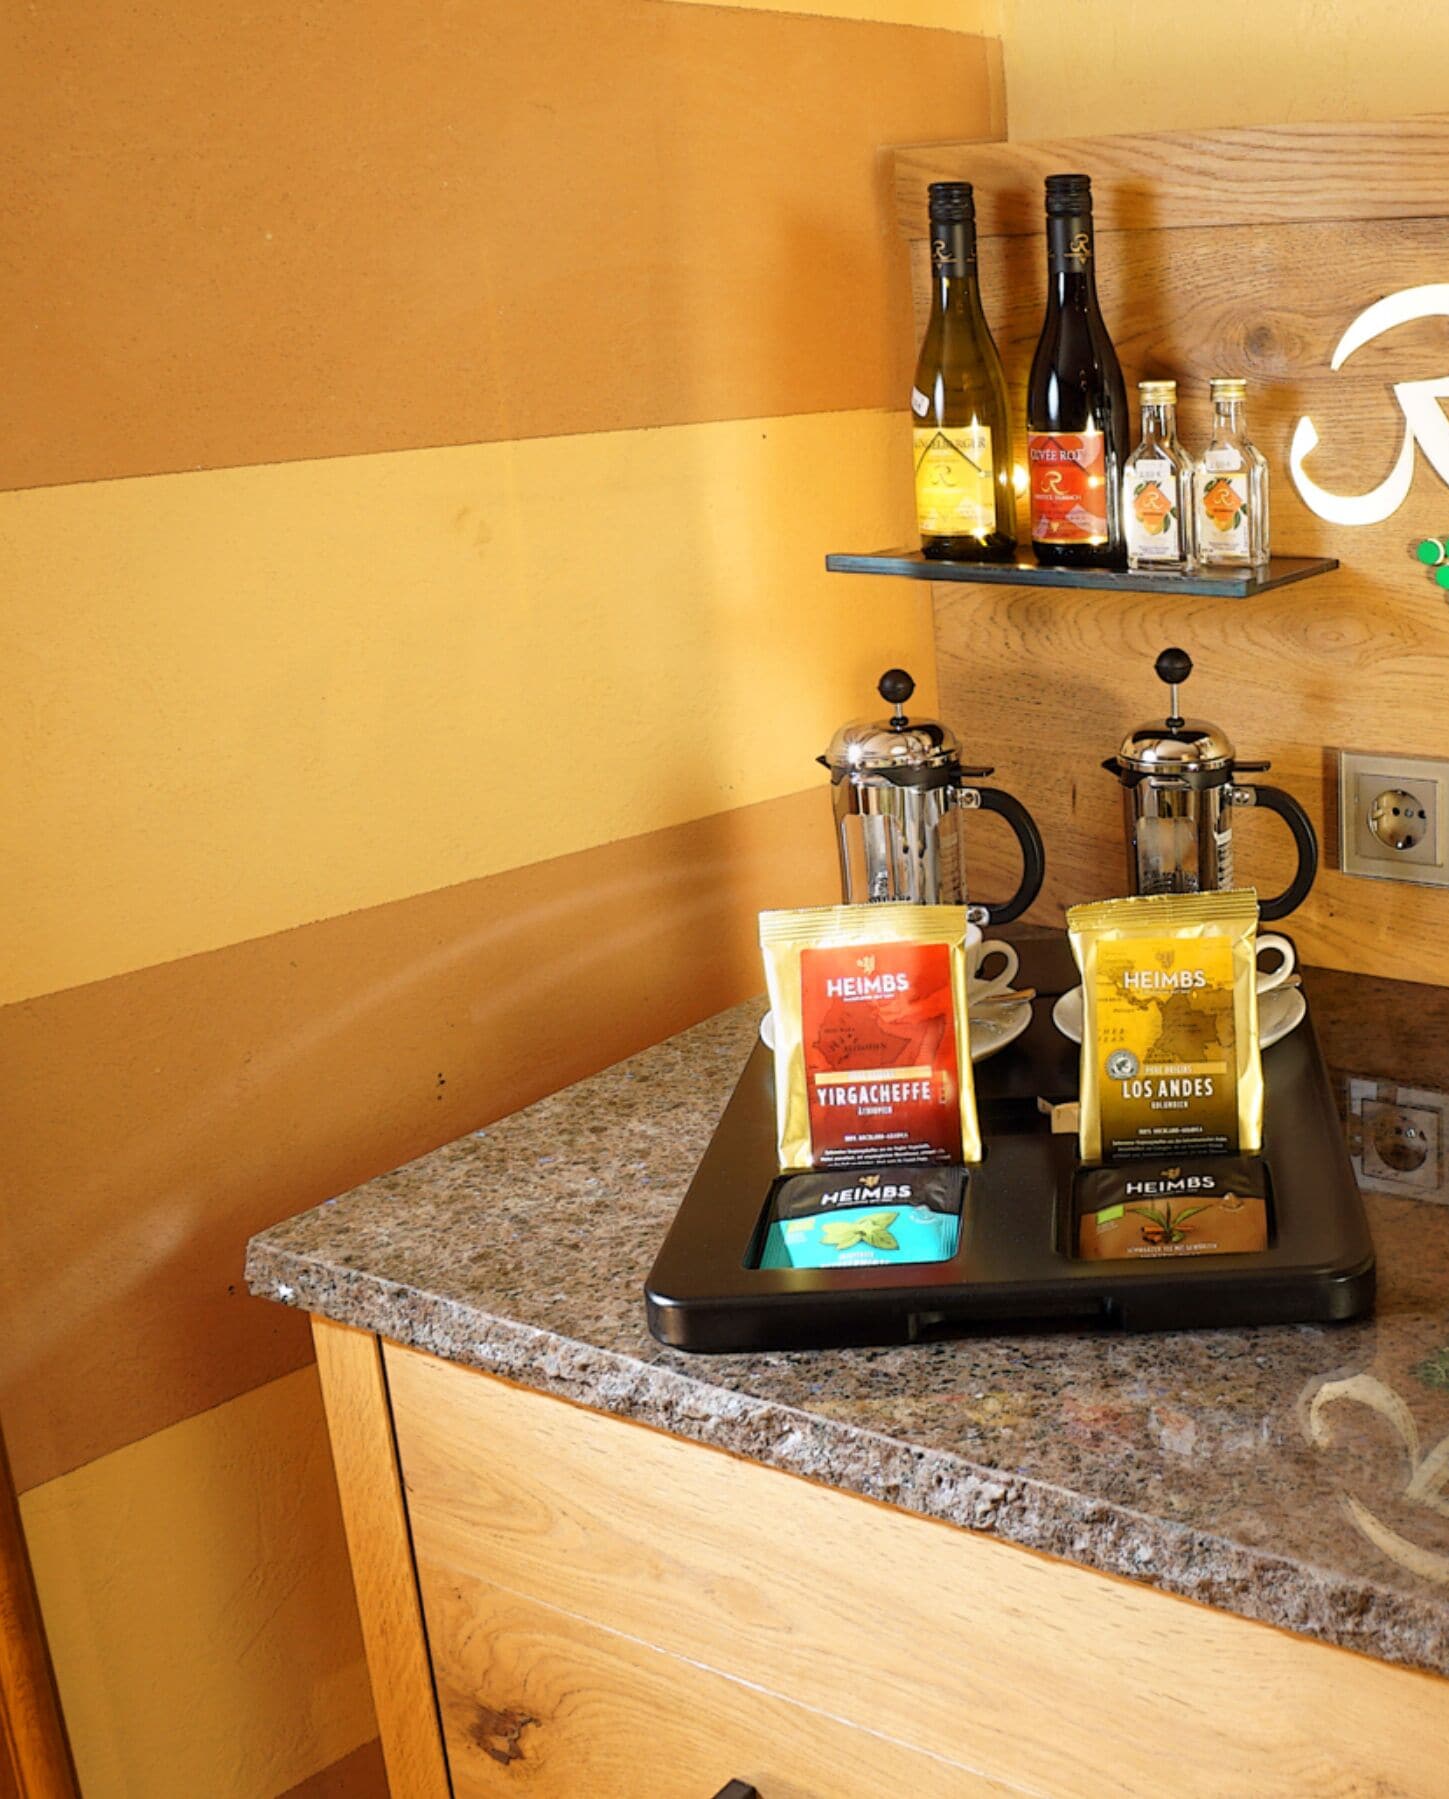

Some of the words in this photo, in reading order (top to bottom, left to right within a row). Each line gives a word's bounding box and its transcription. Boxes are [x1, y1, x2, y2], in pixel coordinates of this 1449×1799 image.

[826, 972, 910, 998] HEIMBS
[1123, 969, 1208, 989] HEIMBS
[816, 1081, 931, 1106] YIRGACHEFFE
[1122, 1079, 1153, 1099] LOS
[1157, 1077, 1214, 1098] ANDES
[820, 1184, 912, 1206] HEIMBS
[1126, 1176, 1216, 1195] HEIMBS
